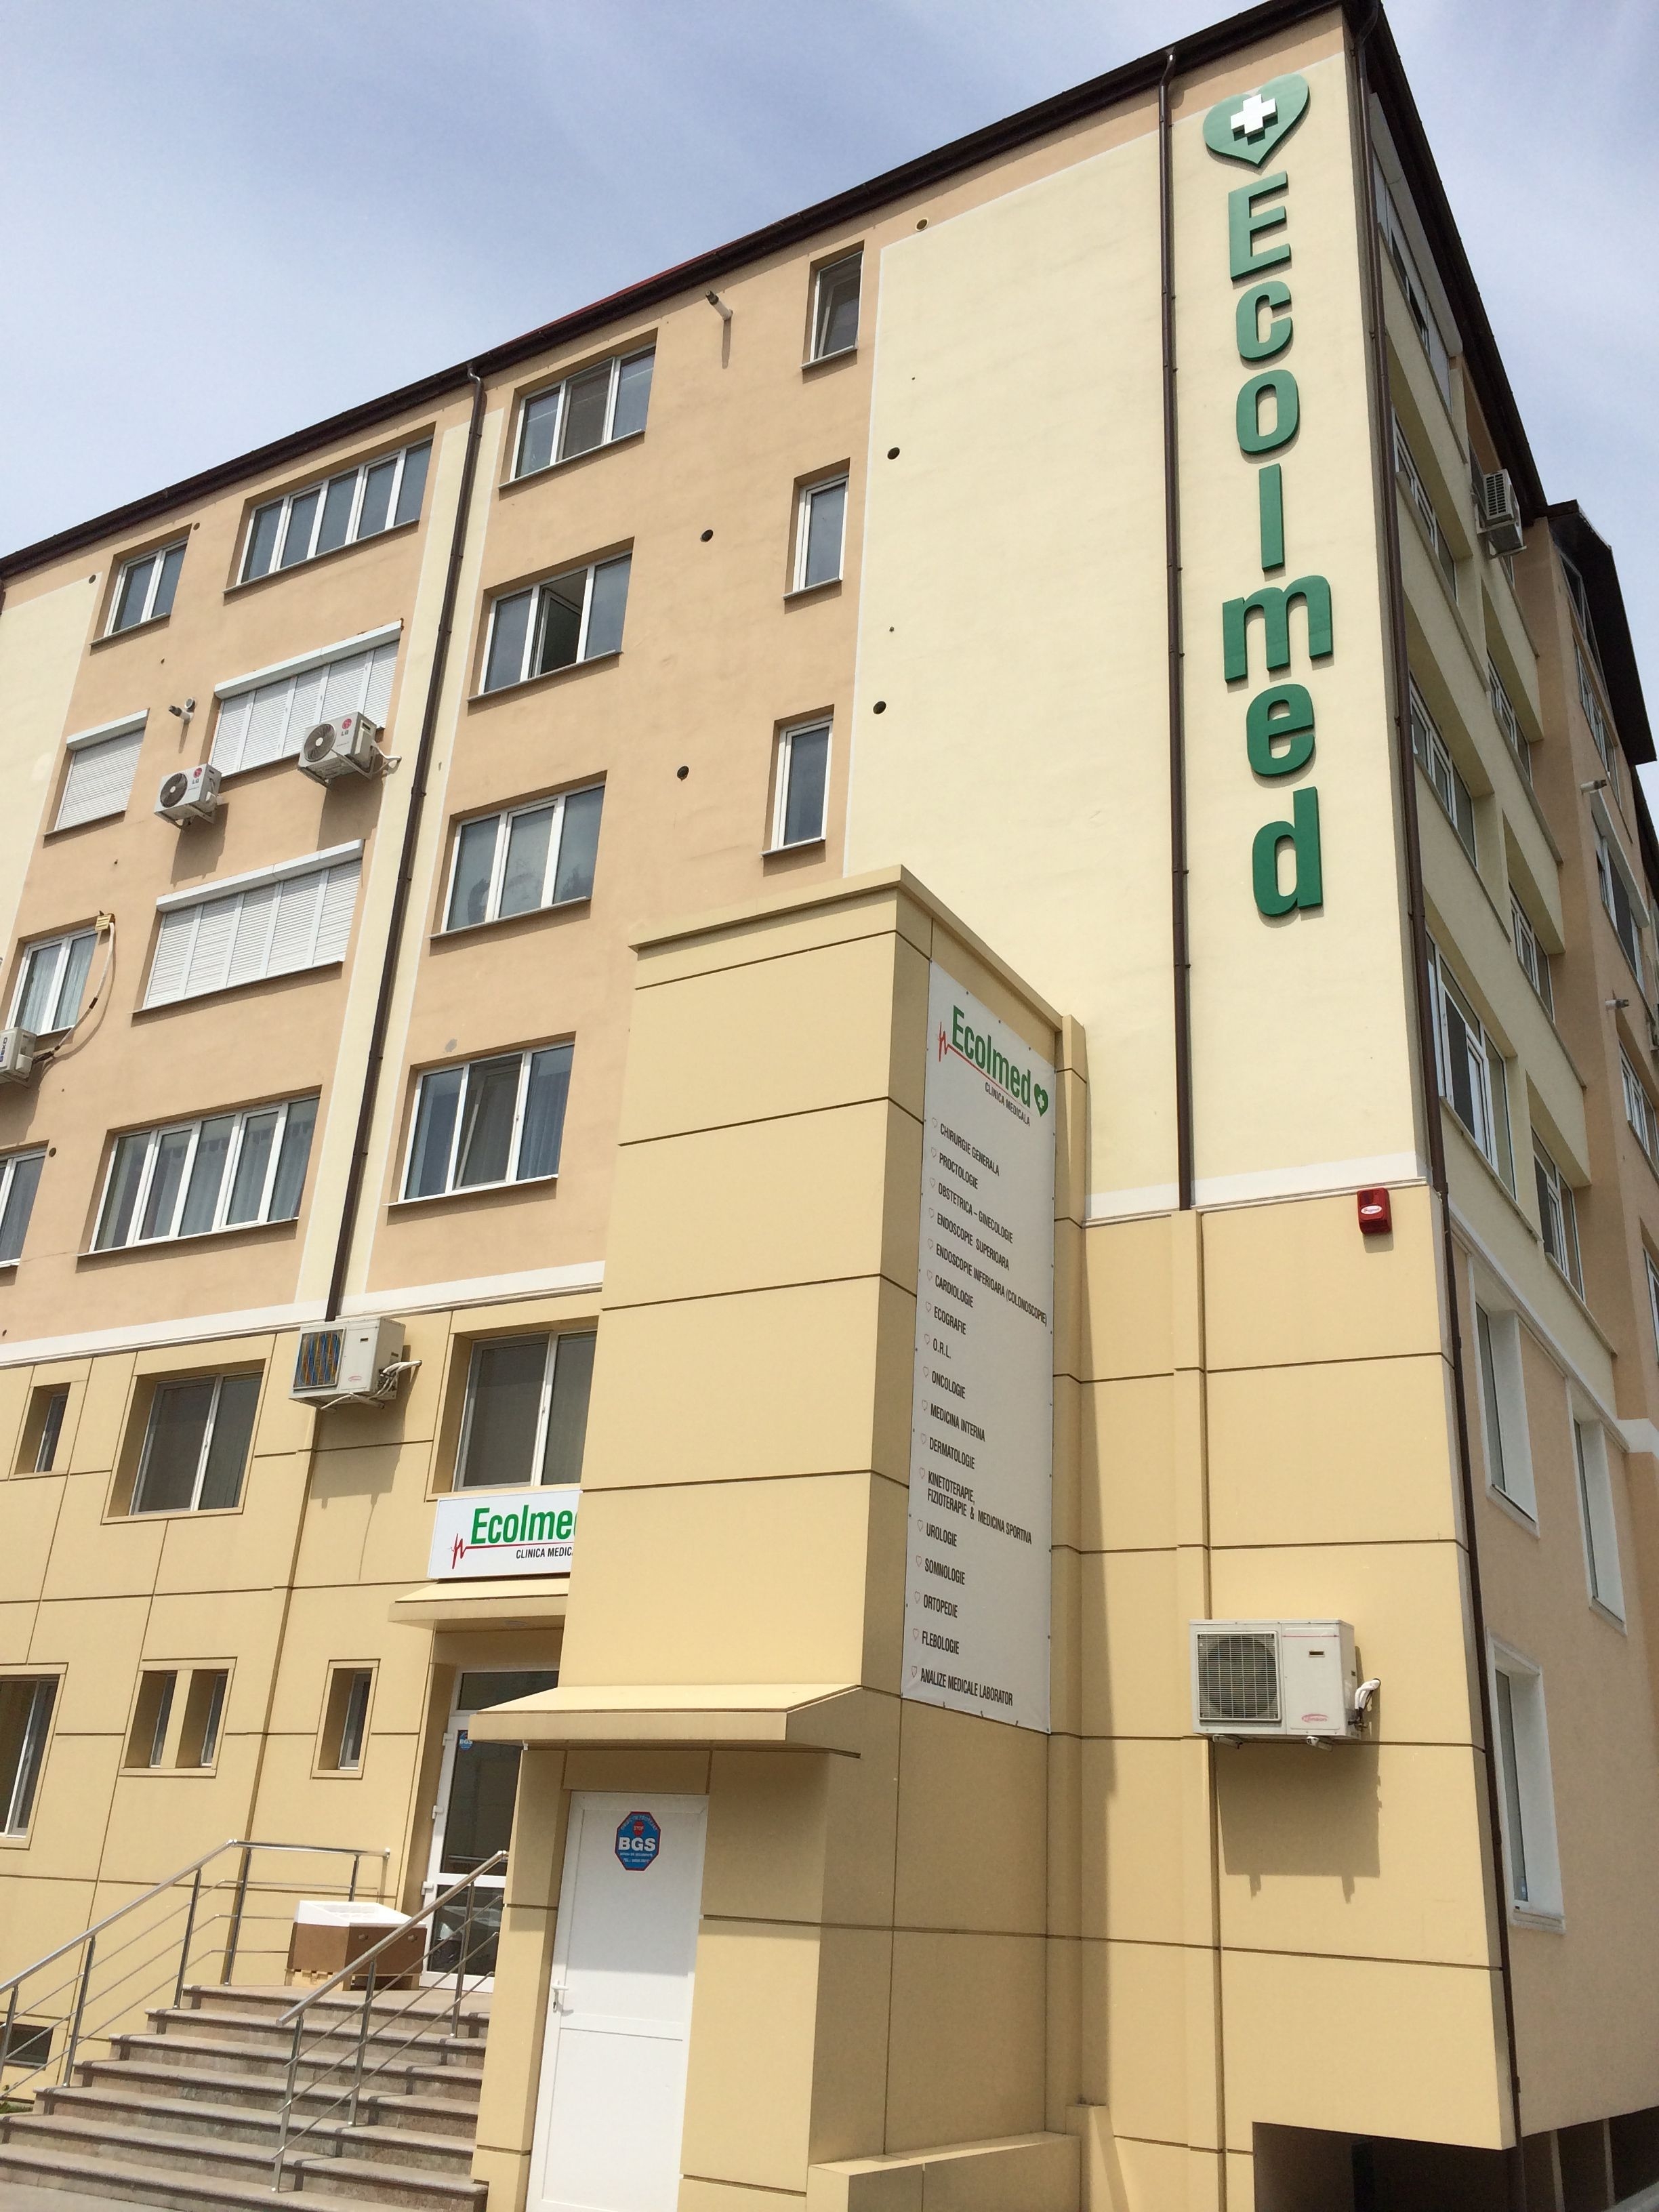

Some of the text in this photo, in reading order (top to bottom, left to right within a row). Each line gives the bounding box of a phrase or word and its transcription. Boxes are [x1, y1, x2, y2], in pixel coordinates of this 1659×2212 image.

[1223, 171, 1333, 917] Ecolmed
[952, 1005, 1031, 1109] Ecolmed
[985, 1082, 1030, 1126] CLINICA MEDICALA
[940, 1123, 1000, 1176] CHIRURGIE GENERALA
[939, 1152, 978, 1189] PROCTOLOGIE
[939, 1183, 972, 1216] OBSTETRICA
[979, 1210, 1013, 1244] GINECOLOGIE
[937, 1212, 1009, 1271] ENDOSCOPIE SUPERIOARA
[935, 1275, 973, 1308] CARDIOLOGIE
[937, 1243, 1047, 1327] ENDOSCOPIE INFERIOARA (COLONOSCOPIE)
[934, 1306, 966, 1335] ECOGRAFIE
[933, 1338, 951, 1359] O.R.L.
[932, 1370, 966, 1399] ONCOLOGIE
[930, 1403, 985, 1442] MEDICINA INTERNA
[929, 1437, 975, 1470] DERMATOLOGIE
[928, 1471, 975, 1505] KINETOTERAPIE,
[471, 1504, 577, 1544] Ecolme
[928, 1488, 1032, 1545] FIZIOTERAPIE & MEDICINA SPORTIVA
[926, 1523, 958, 1547] UROLOGIE
[516, 1547, 573, 1559] CLINICA MEDIC
[924, 1558, 966, 1585] SOMNOLOGIE
[923, 1594, 958, 1618] ORTOPEDIE
[922, 1631, 959, 1655] FLEBOLOGIE
[920, 1668, 1013, 1706] ANALIZE MEDICALE LABORATOR
[618, 1837, 656, 1851] BGS
